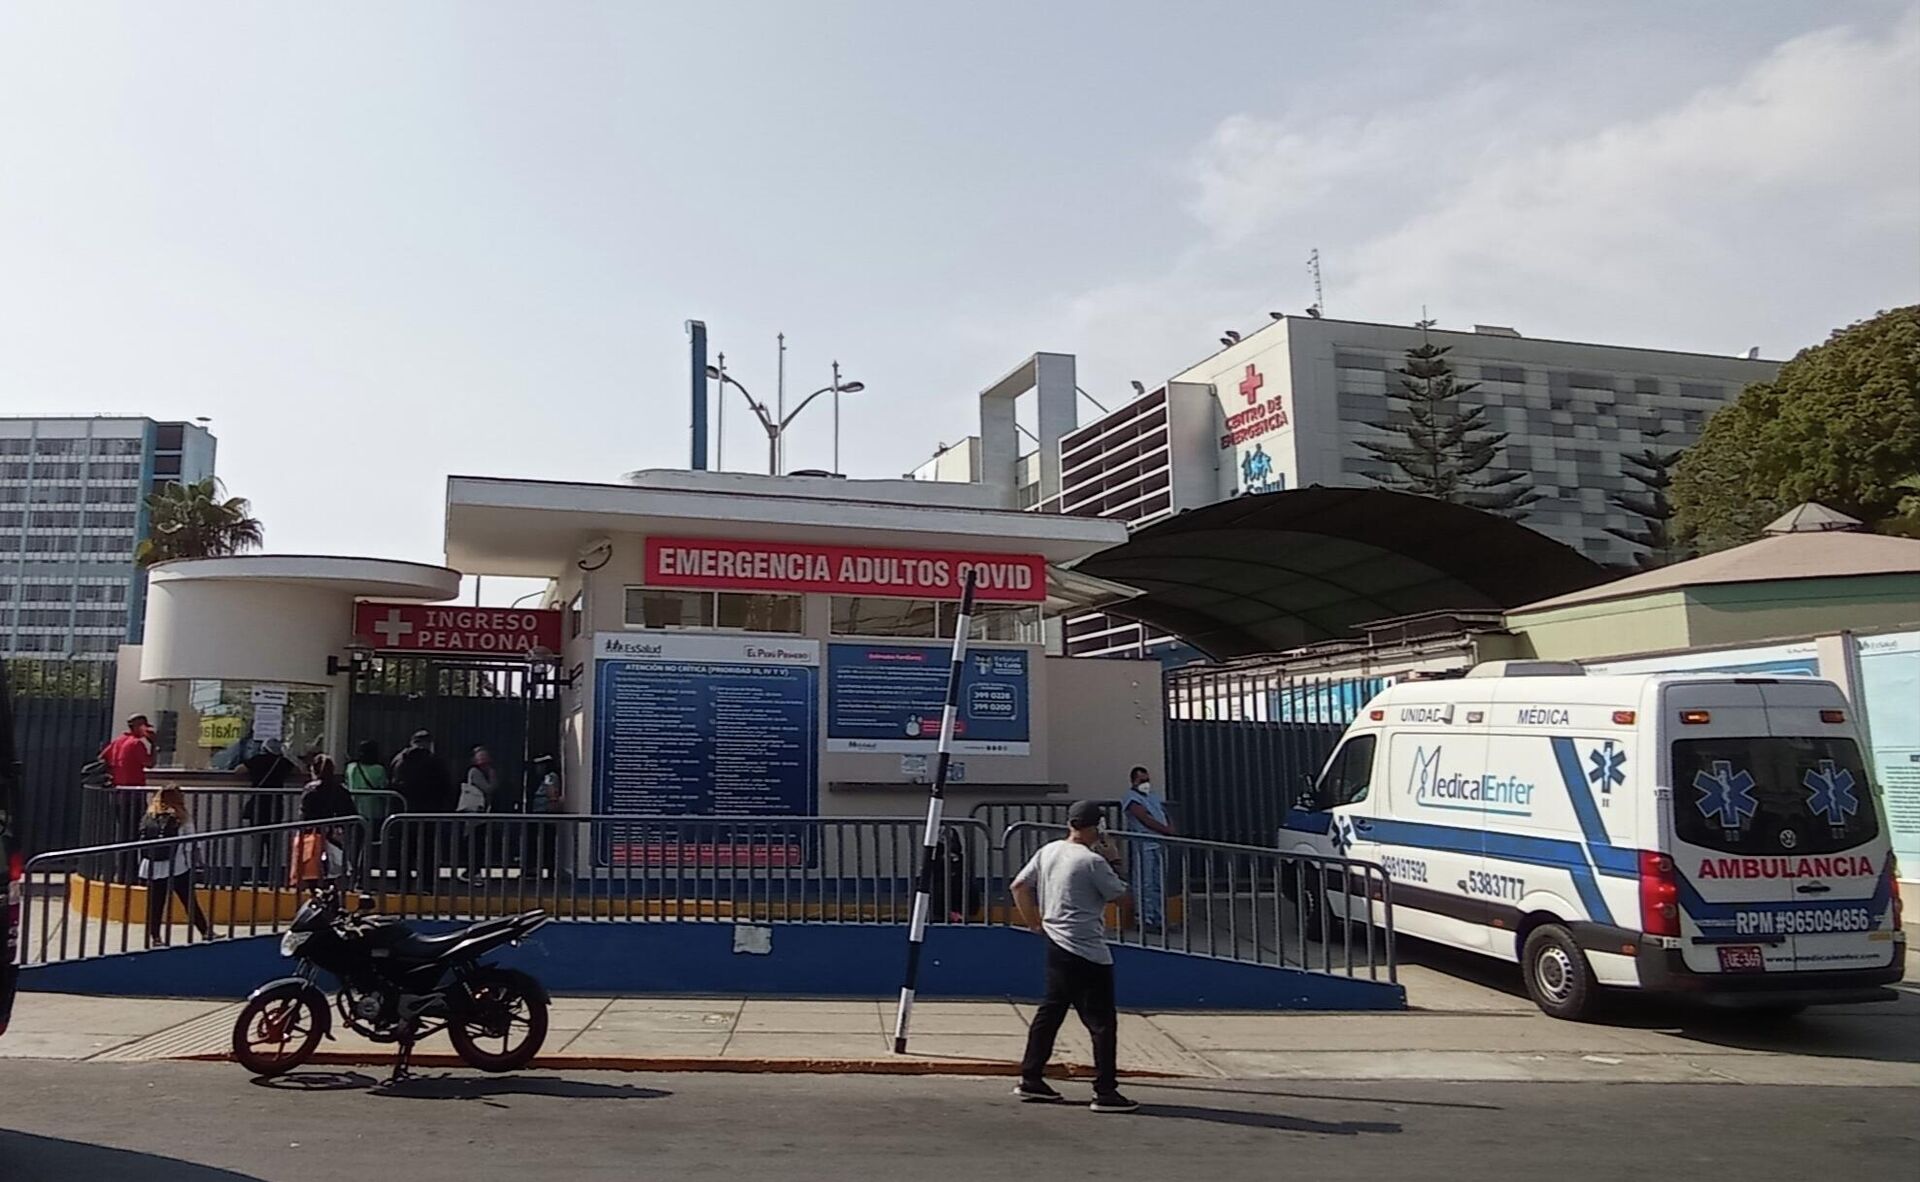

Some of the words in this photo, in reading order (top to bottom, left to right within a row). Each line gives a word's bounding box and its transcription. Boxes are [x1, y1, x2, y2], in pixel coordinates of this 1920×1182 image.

[1225, 404, 1266, 430] CENTRO
[1267, 395, 1283, 414] DE
[1221, 410, 1289, 450] EMERGENCIA
[658, 547, 830, 582] EMERGENCIA
[838, 555, 950, 587] ADULTOS
[957, 561, 1032, 590] COVID
[425, 610, 538, 631] INGRESO
[625, 663, 664, 672] ATENCIÓN
[665, 665, 676, 673] NO
[677, 664, 707, 674] CRÍTICA
[1517, 705, 1570, 725] MÉDICA
[1407, 745, 1535, 805] MedicalEnfer
[1698, 856, 1875, 879] AMBULANCIA
[1469, 869, 1525, 900] 5383777
